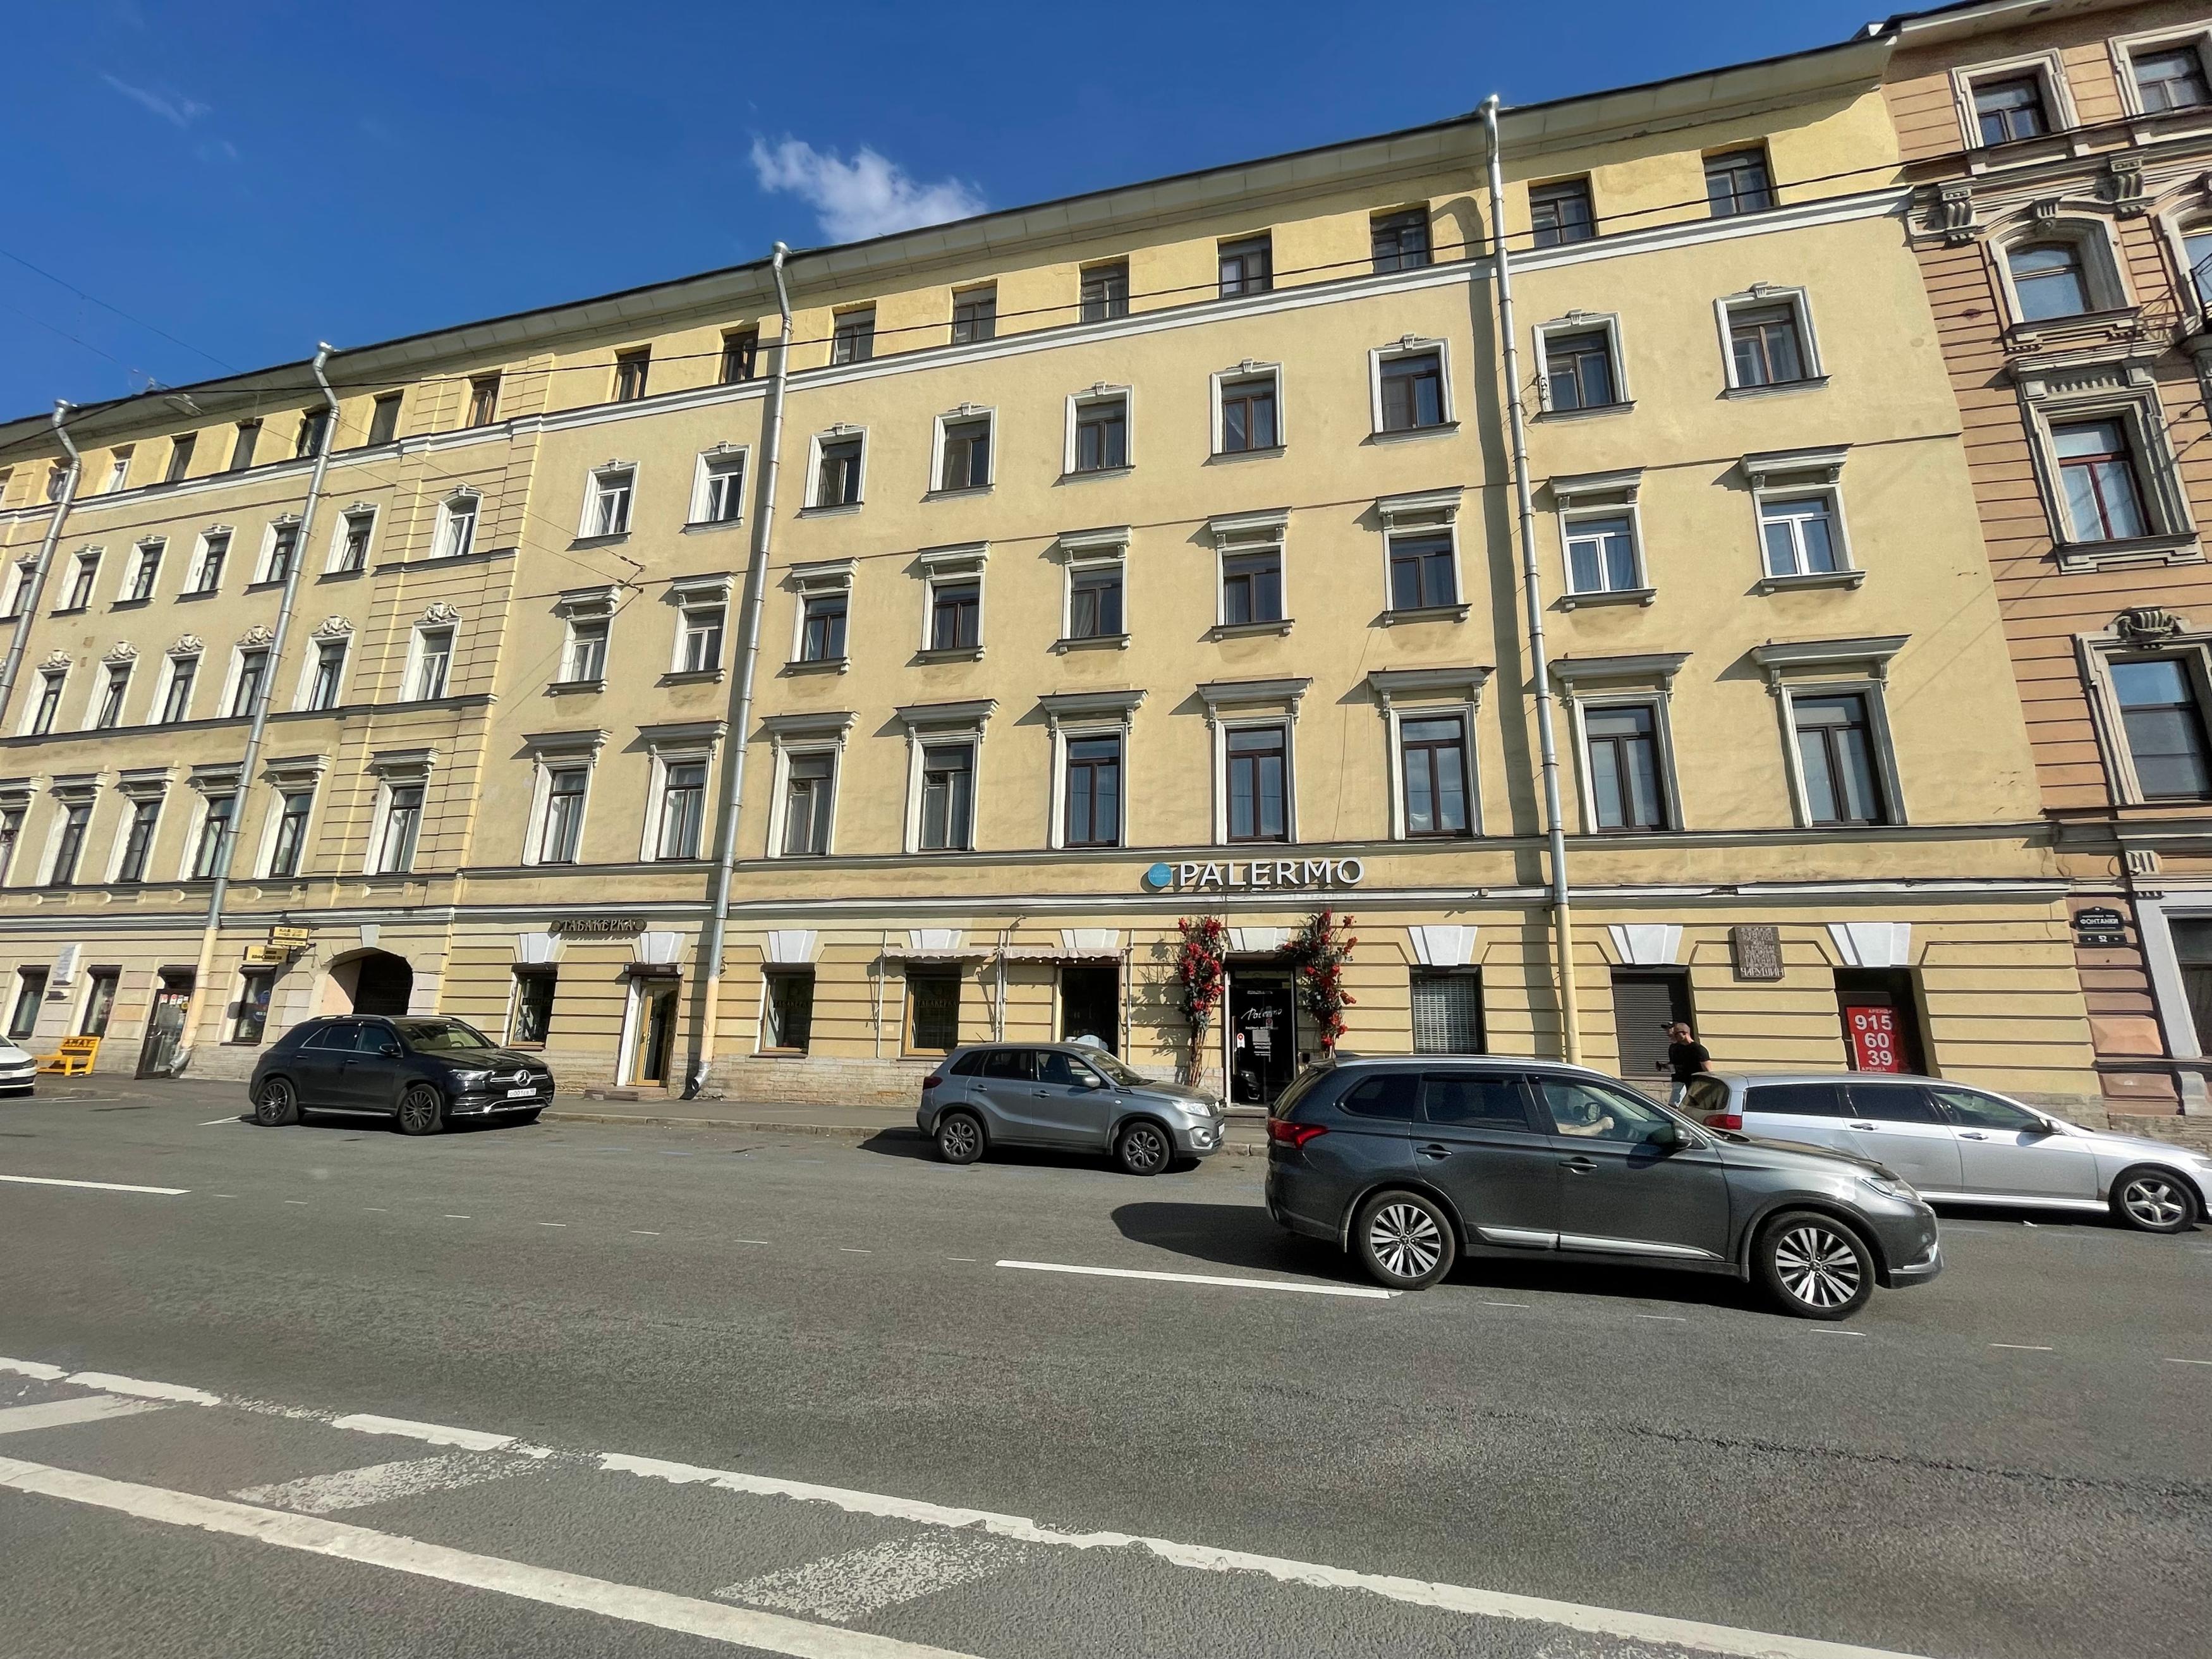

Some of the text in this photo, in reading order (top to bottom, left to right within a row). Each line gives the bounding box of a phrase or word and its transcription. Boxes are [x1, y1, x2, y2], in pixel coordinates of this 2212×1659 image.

[1180, 856, 1365, 886] PALERMO
[562, 919, 633, 932] ТАБАКЕРКА
[1740, 967, 1784, 976] ЧАРУШИН
[1854, 1014, 1893, 1030] 915
[1864, 1032, 1890, 1048] 60
[1867, 1050, 1893, 1066] 39
